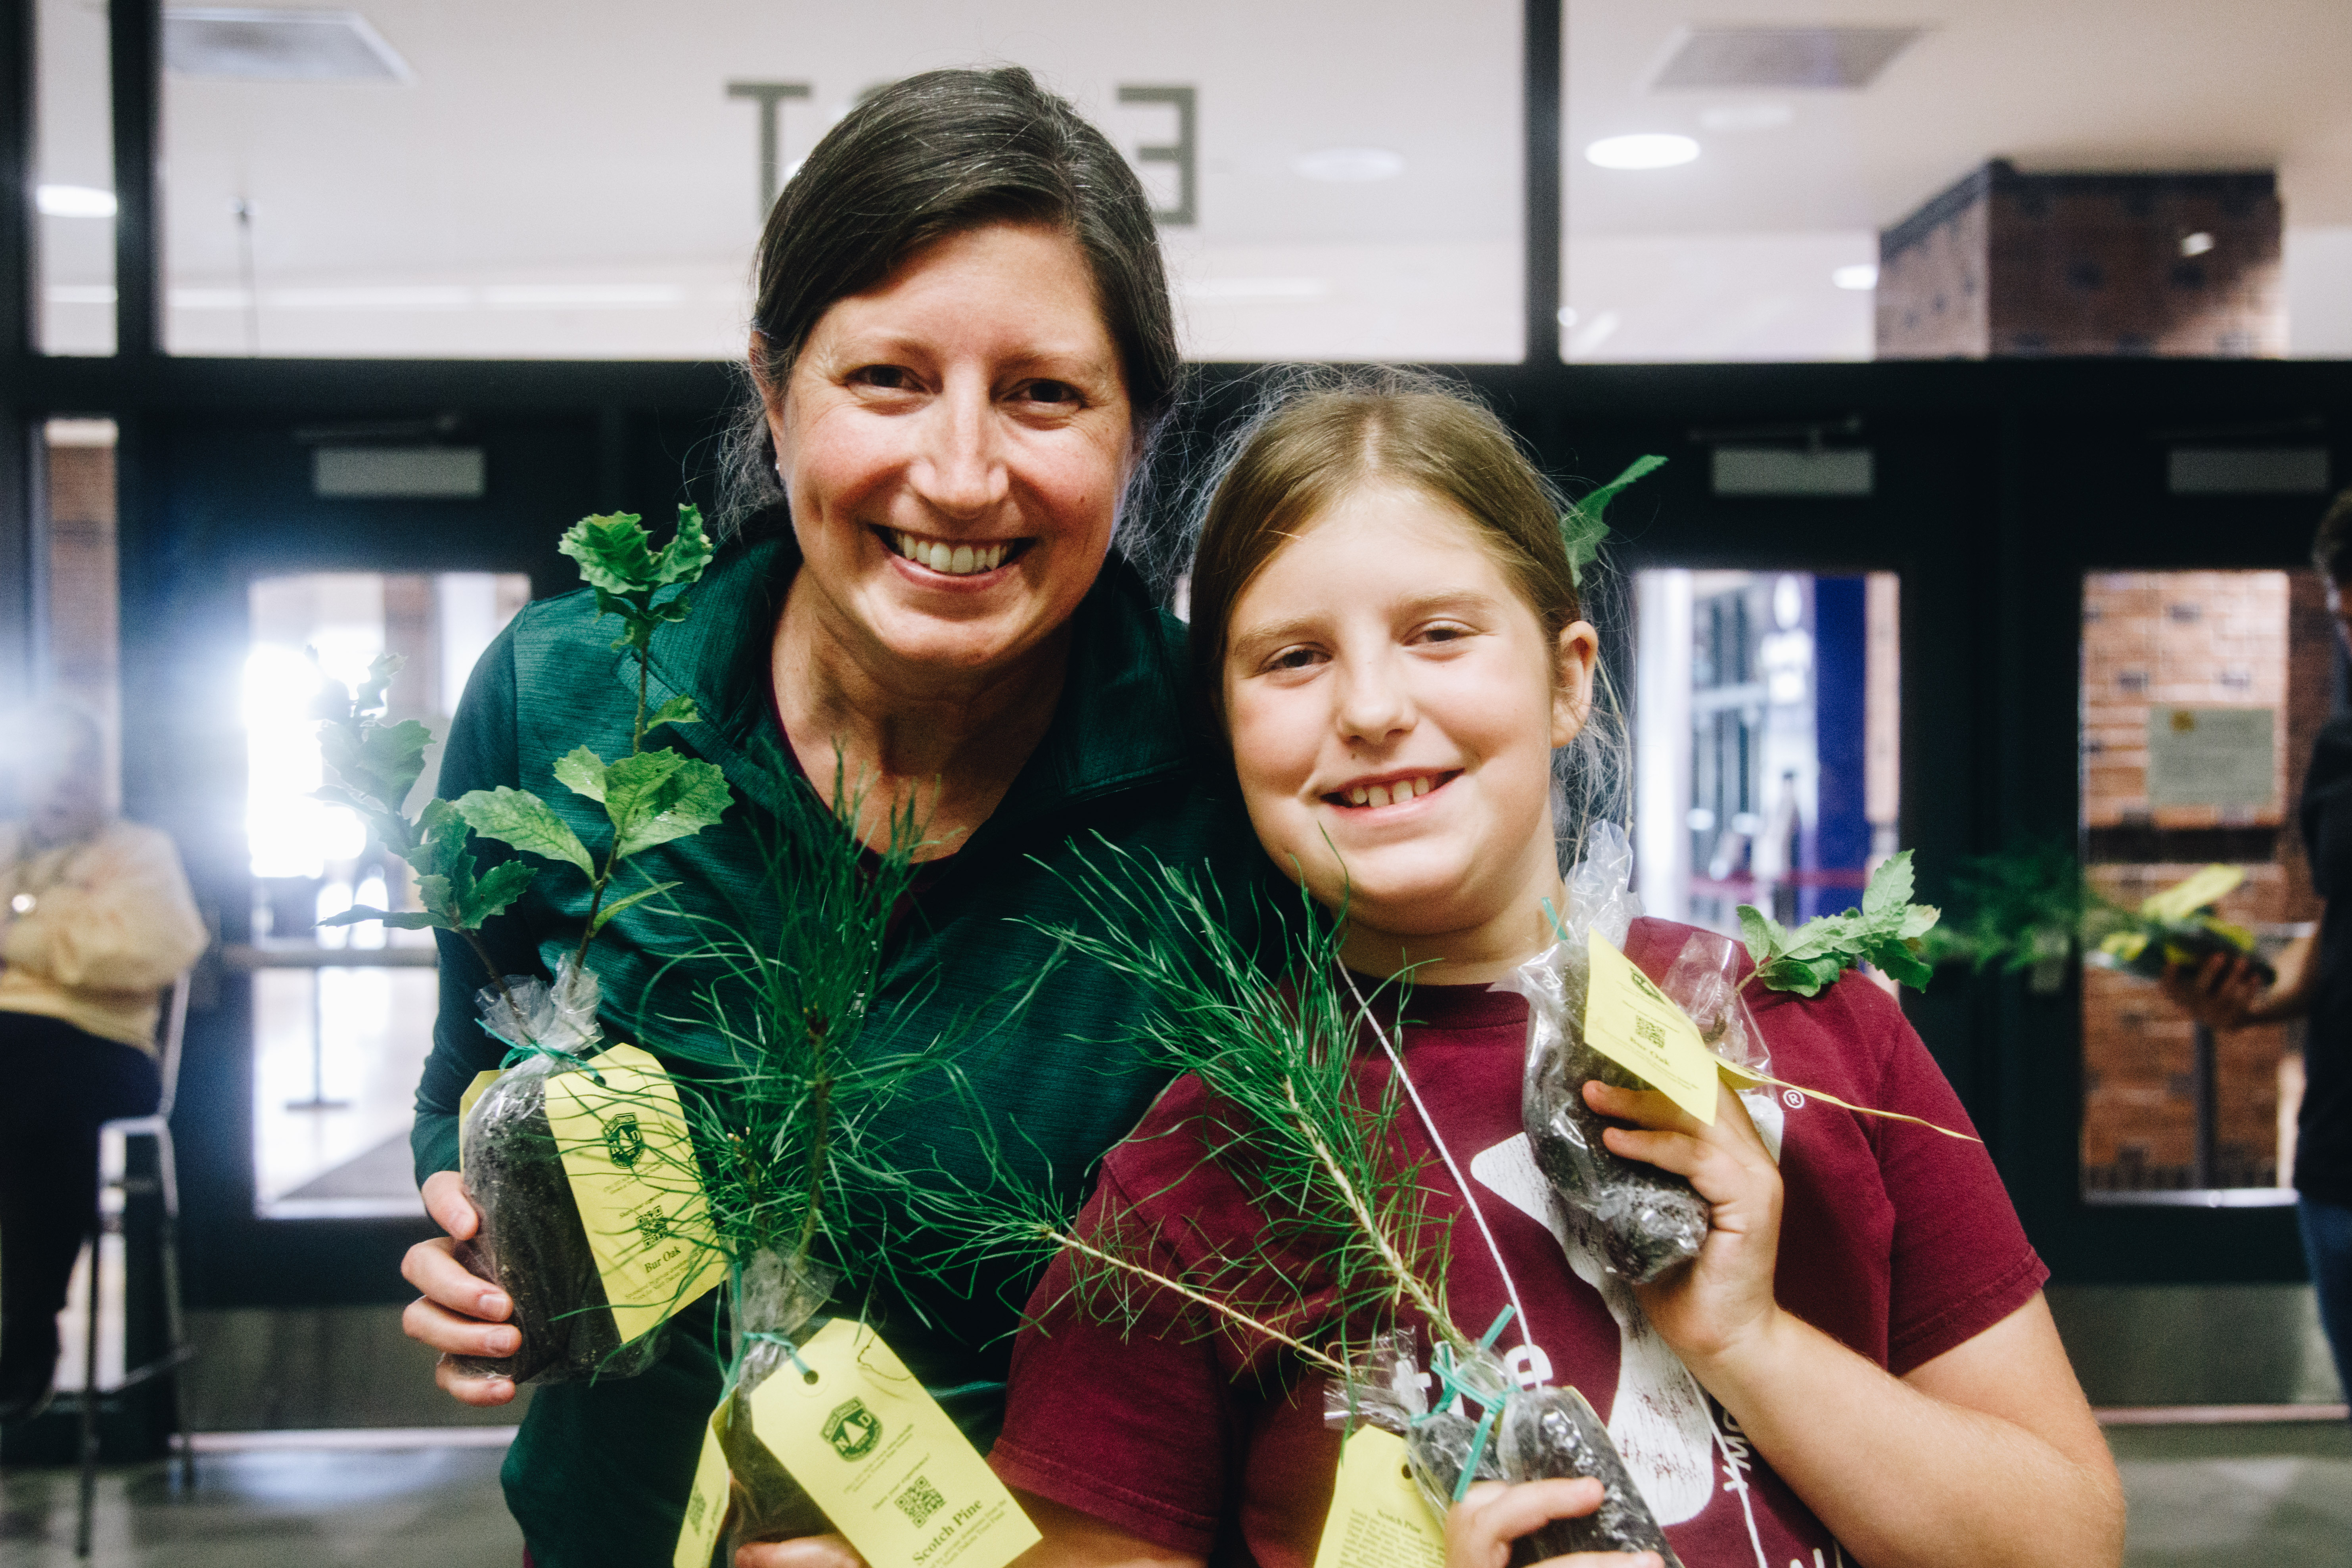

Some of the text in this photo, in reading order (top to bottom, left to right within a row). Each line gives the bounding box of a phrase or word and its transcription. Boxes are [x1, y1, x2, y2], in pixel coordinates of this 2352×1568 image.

[644, 1258, 662, 1273] Bur
[661, 1246, 681, 1262] Oak
[857, 1412, 871, 1427] D
[912, 1499, 983, 1564] Scotch Pine
